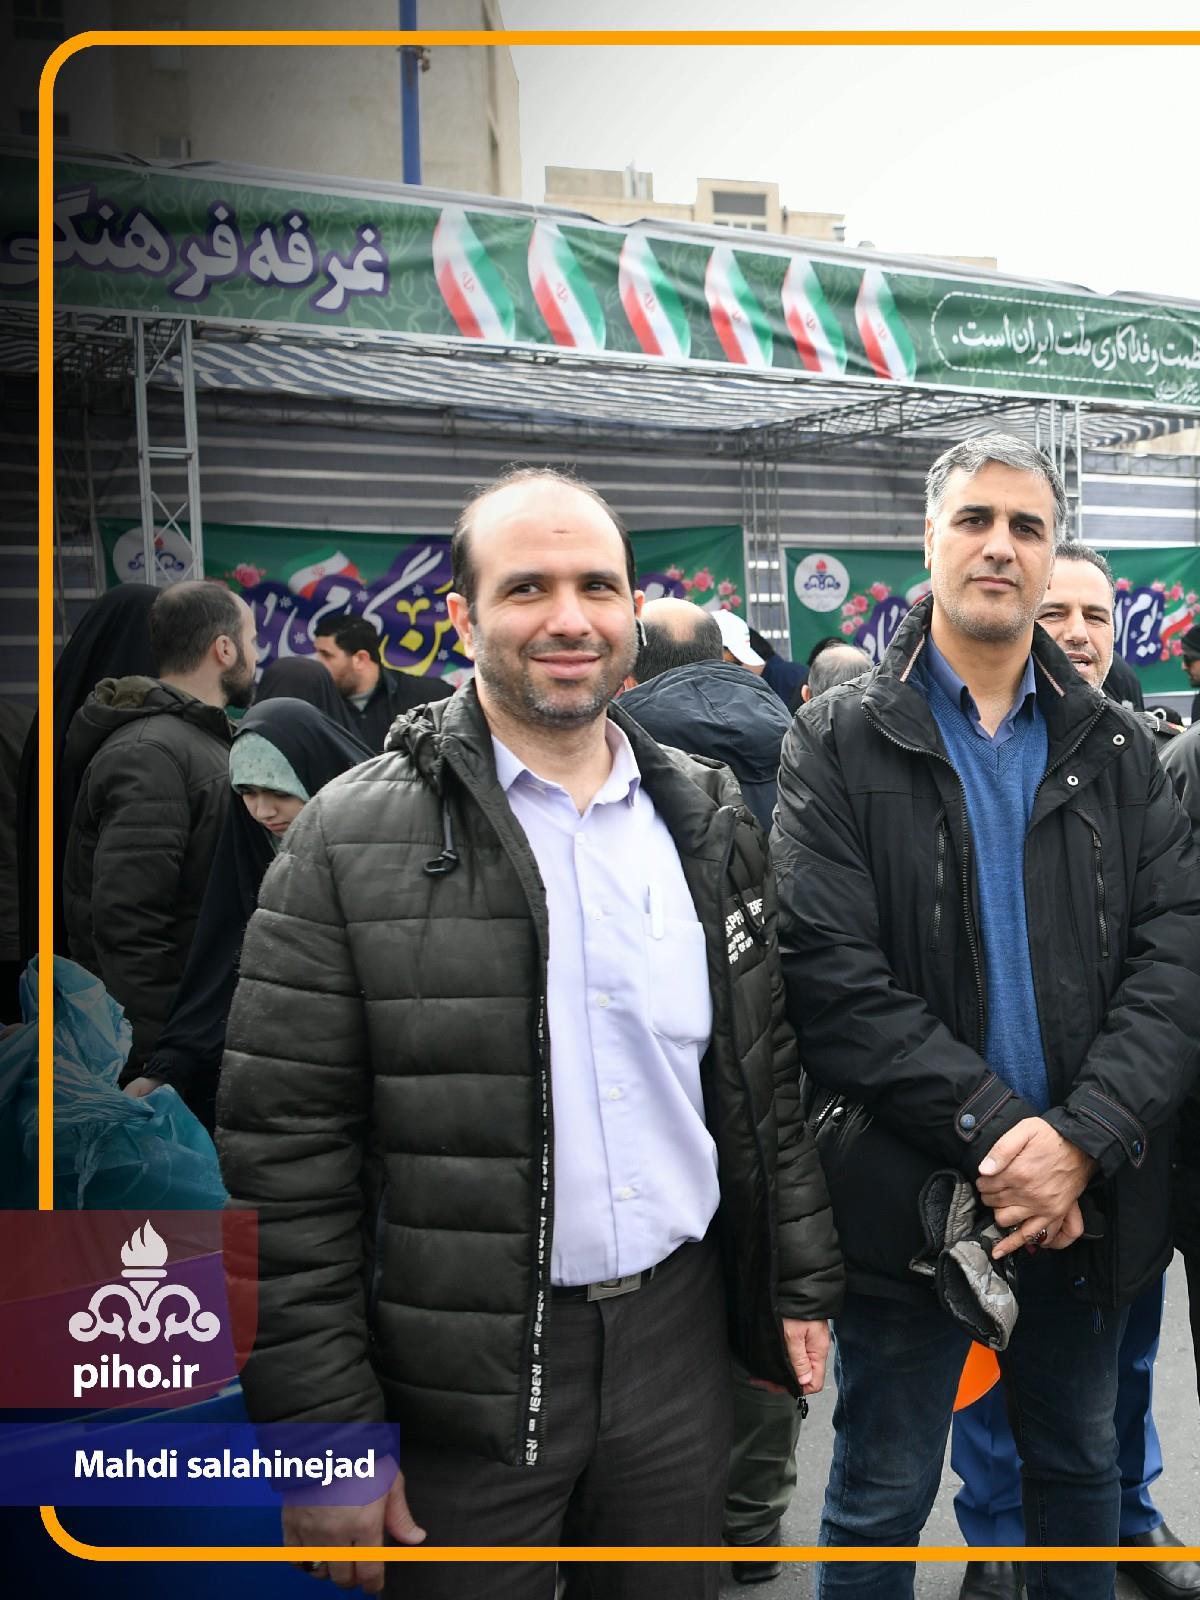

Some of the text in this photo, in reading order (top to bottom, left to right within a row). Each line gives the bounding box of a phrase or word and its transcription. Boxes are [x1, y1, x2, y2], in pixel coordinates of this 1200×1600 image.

[249, 215, 384, 309] غرفه
[1011, 314, 1054, 366] ایران
[1091, 325, 1150, 371] فداکاری
